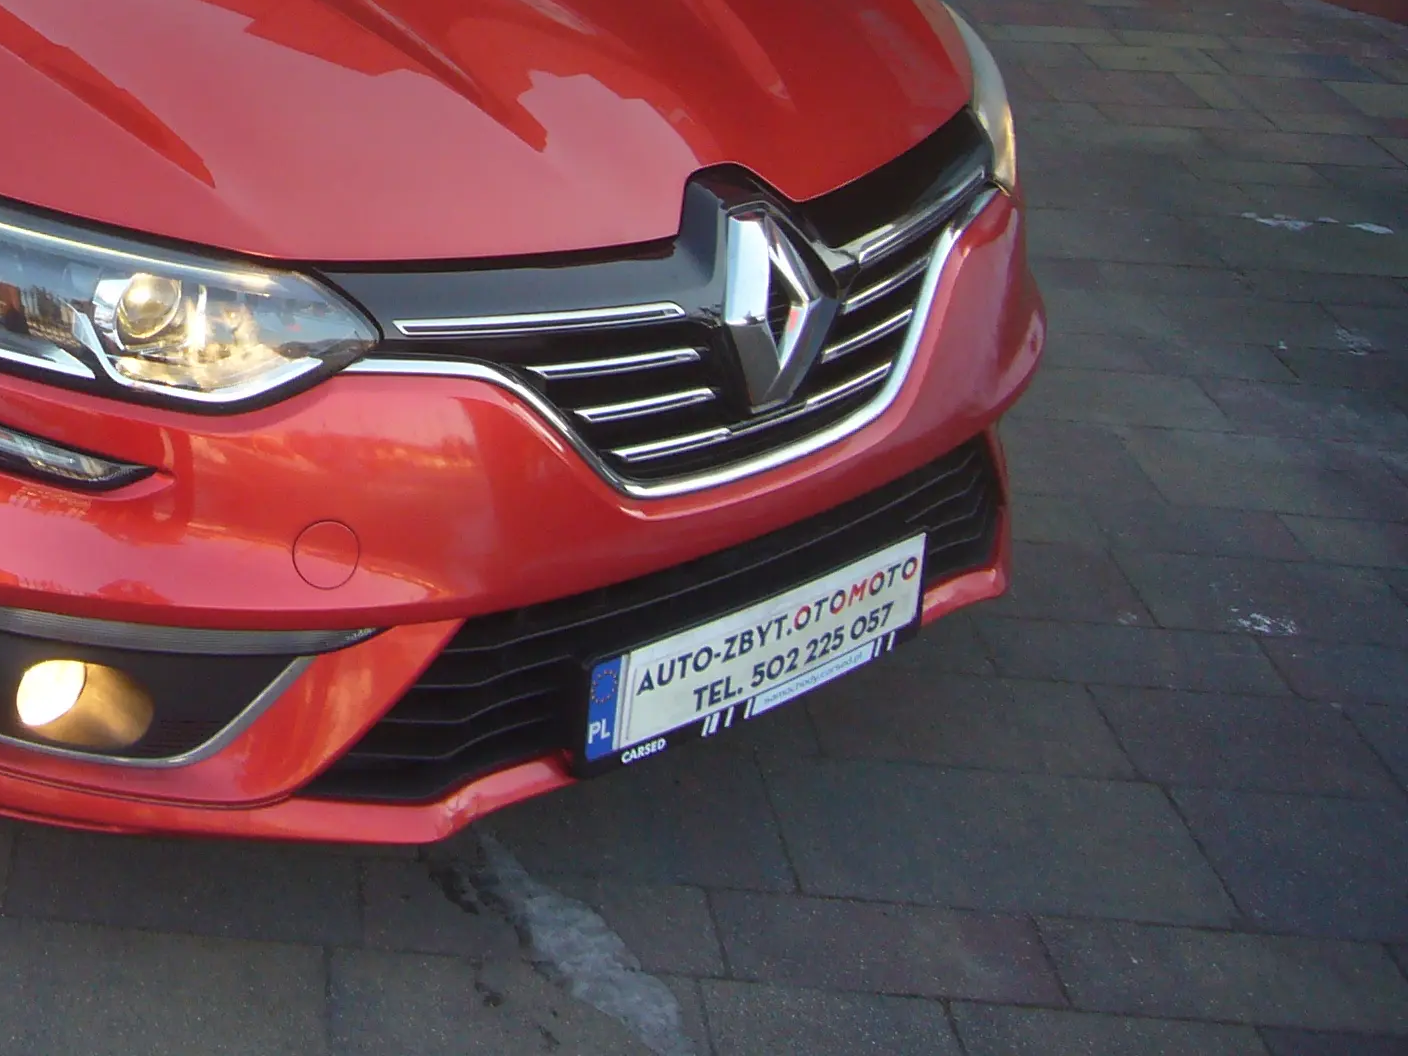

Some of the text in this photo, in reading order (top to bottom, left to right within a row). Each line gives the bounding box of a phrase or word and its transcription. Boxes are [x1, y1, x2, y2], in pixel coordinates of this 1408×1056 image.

[636, 556, 918, 695] AUTO-ZBYT.OTOMOTO
[693, 601, 894, 712] TEL. 502 225 057
[588, 718, 611, 744] PL
[621, 738, 666, 764] CARSED
